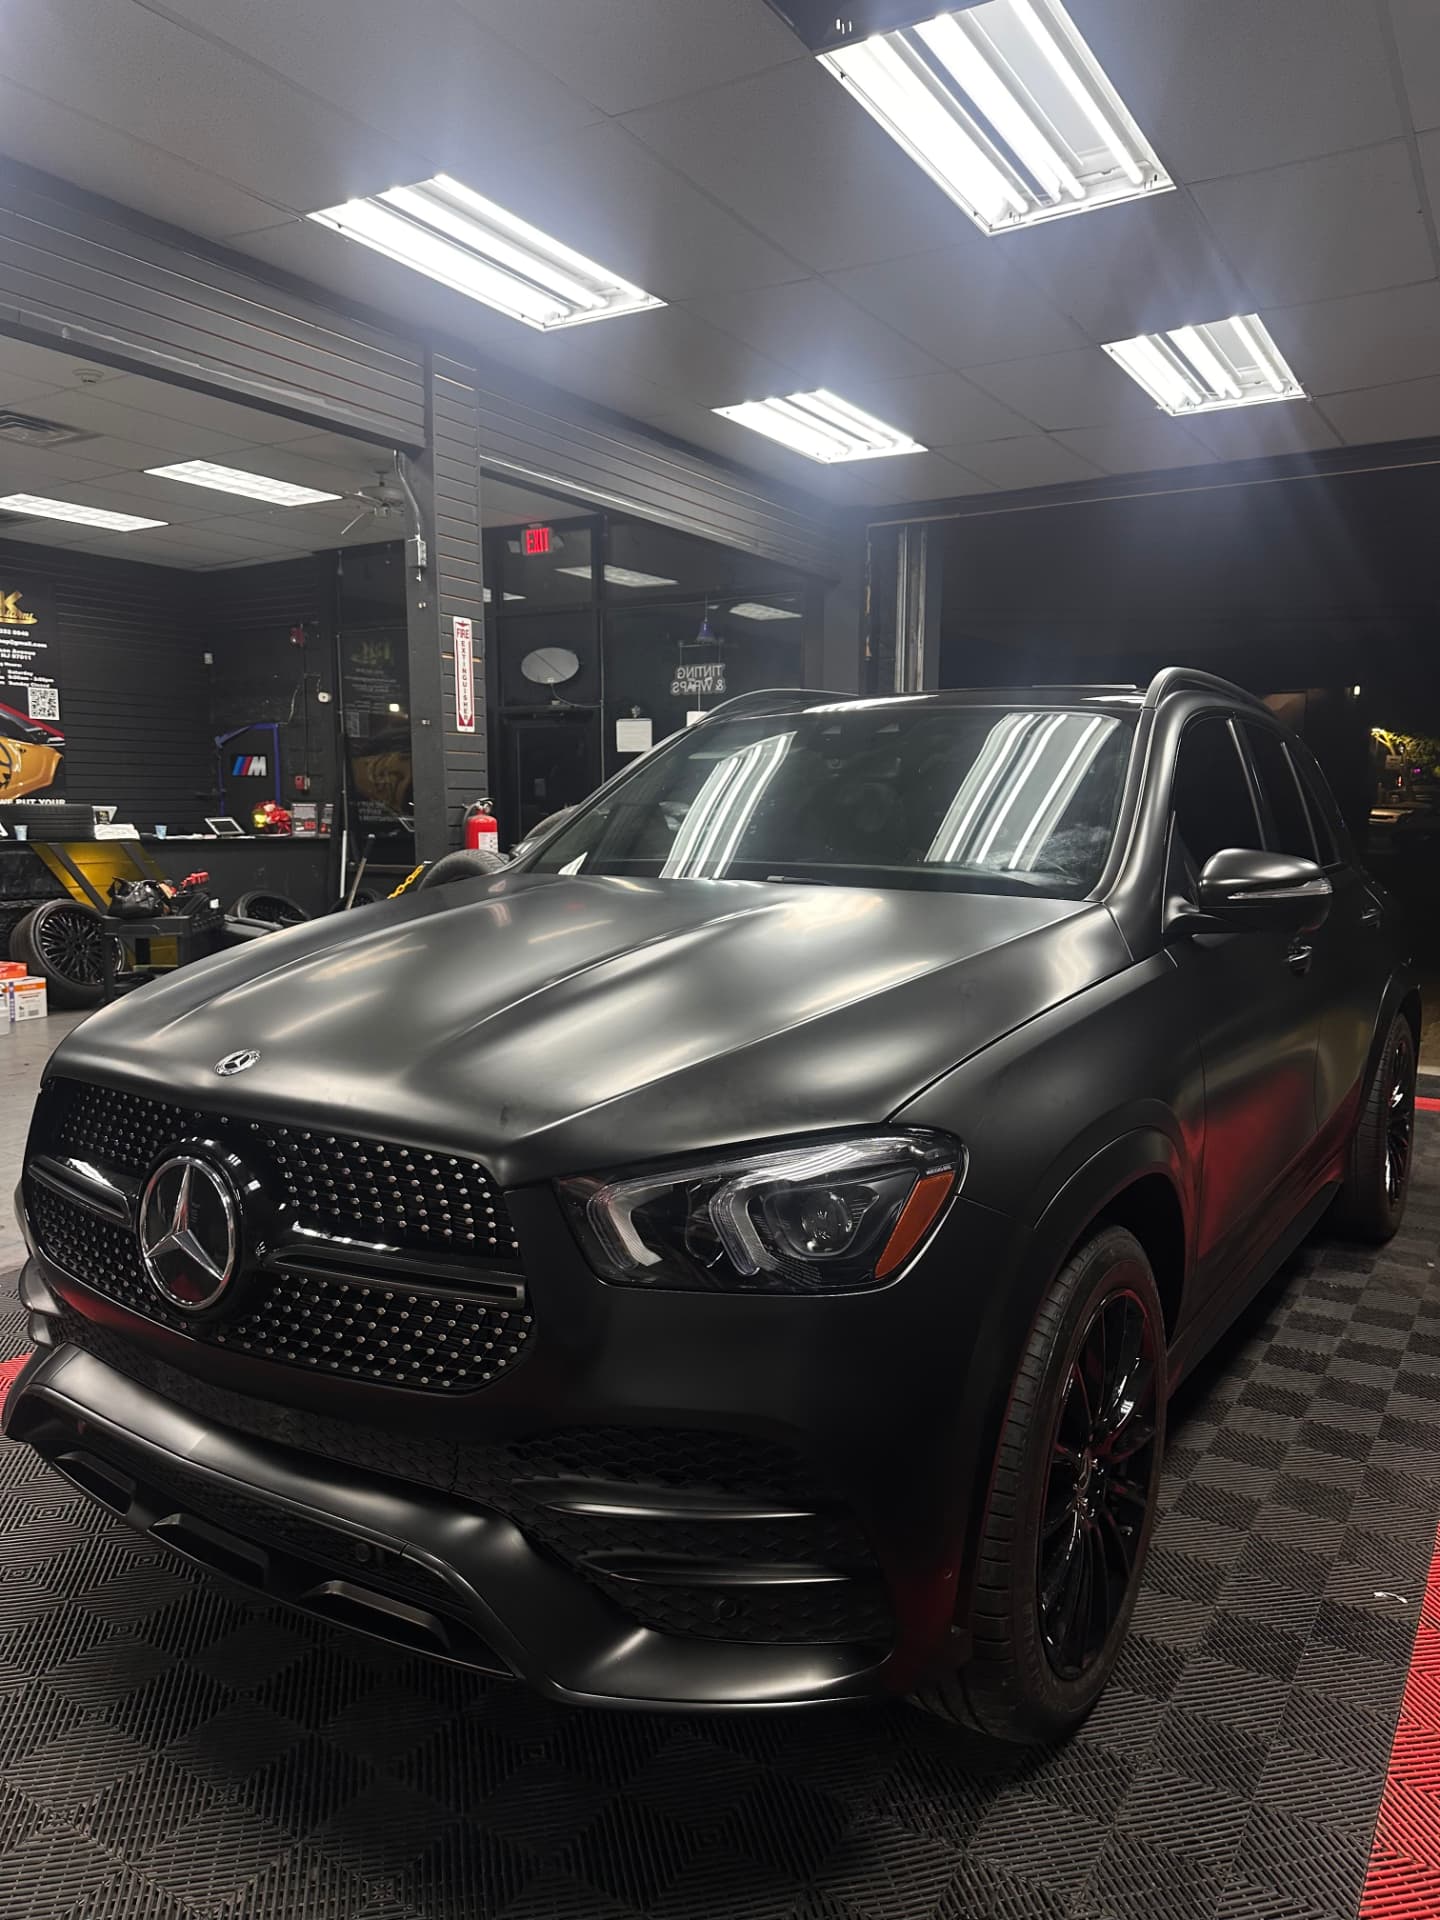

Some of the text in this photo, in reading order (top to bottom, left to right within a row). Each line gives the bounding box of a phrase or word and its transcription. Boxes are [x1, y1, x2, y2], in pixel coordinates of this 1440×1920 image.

[526, 527, 549, 553] EXIT
[457, 628, 470, 639] FIRE
[461, 640, 469, 720] EXTINGUISHER
[247, 756, 267, 776] M
